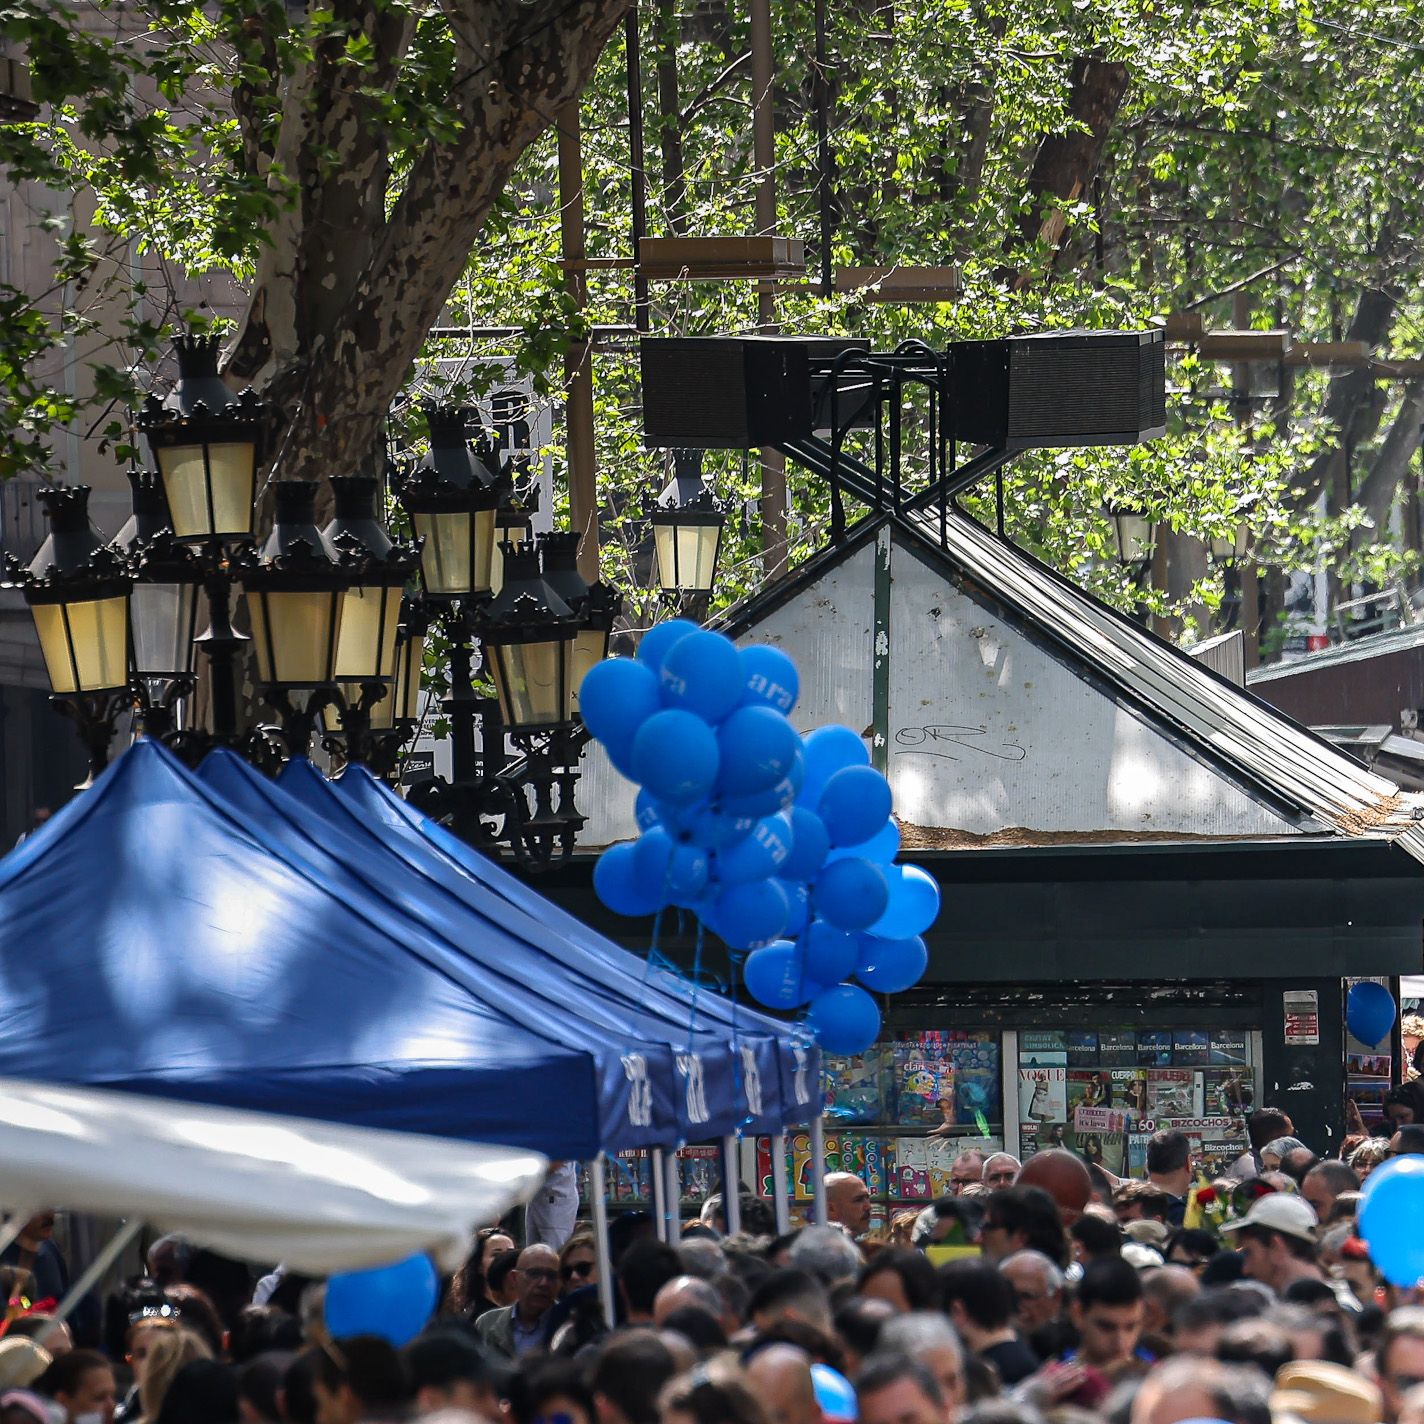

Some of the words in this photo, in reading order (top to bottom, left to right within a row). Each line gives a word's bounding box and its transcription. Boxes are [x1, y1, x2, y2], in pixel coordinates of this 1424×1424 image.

[748, 674, 793, 709] ara
[1101, 1043, 1134, 1051] Barcelona
[1138, 1043, 1171, 1051] Barcelona
[1175, 1042, 1207, 1050] Barcelona
[1211, 1041, 1244, 1049] Barcelona
[1019, 1068, 1065, 1082] VOGUE
[1171, 1118, 1229, 1128] BIZCOCHOS
[1204, 1143, 1244, 1152] Bizcochos
